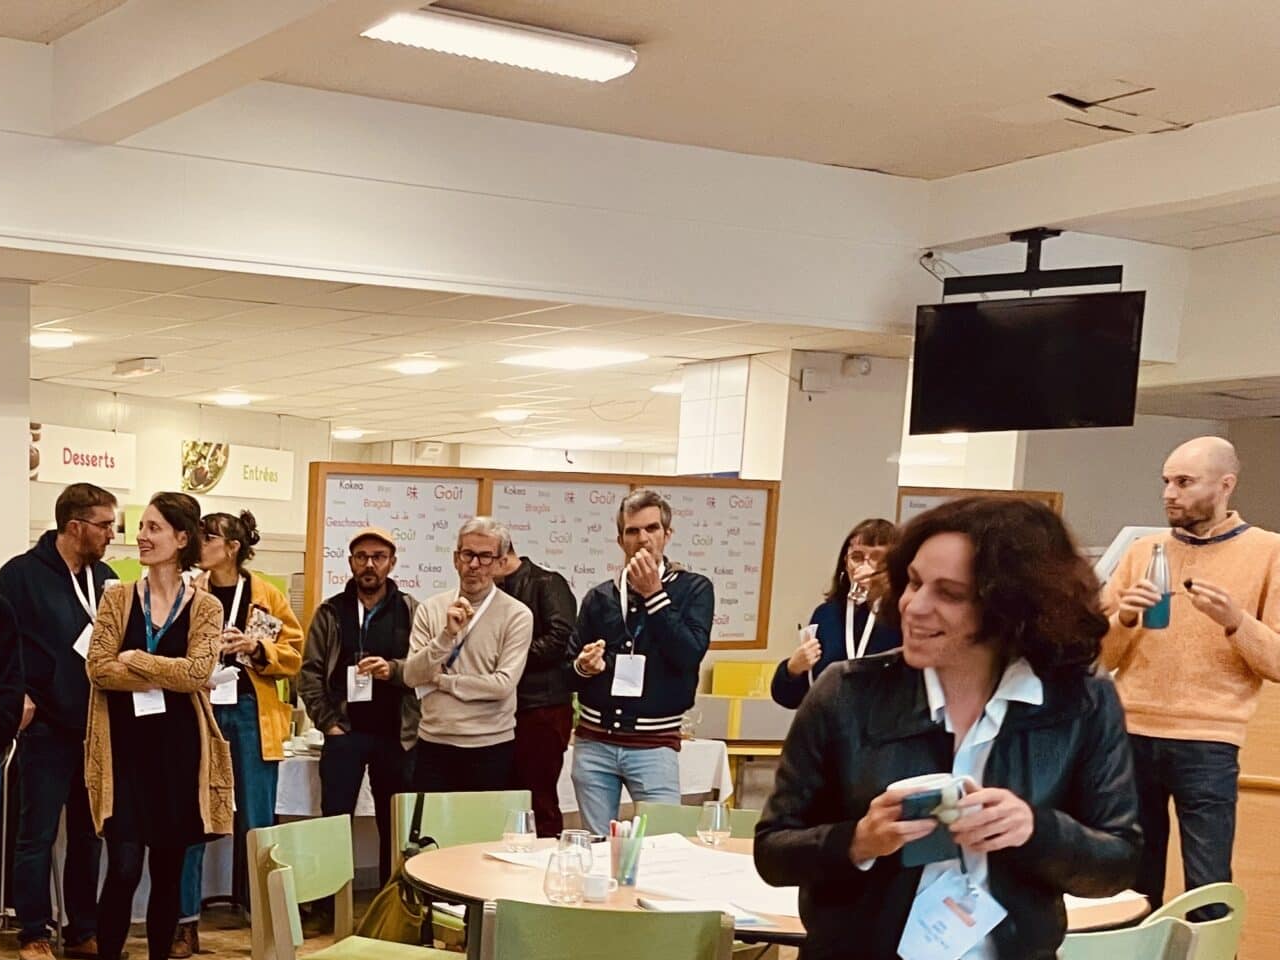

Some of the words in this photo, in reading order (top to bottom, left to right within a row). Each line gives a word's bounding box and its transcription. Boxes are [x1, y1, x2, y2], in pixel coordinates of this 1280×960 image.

[63, 447, 115, 469] Desserts
[243, 464, 278, 483] Entrées
[434, 485, 463, 500] Goût
[590, 490, 616, 504] Goût
[729, 495, 753, 508] Goût
[391, 528, 416, 541] Goût
[328, 571, 350, 585] Tast
